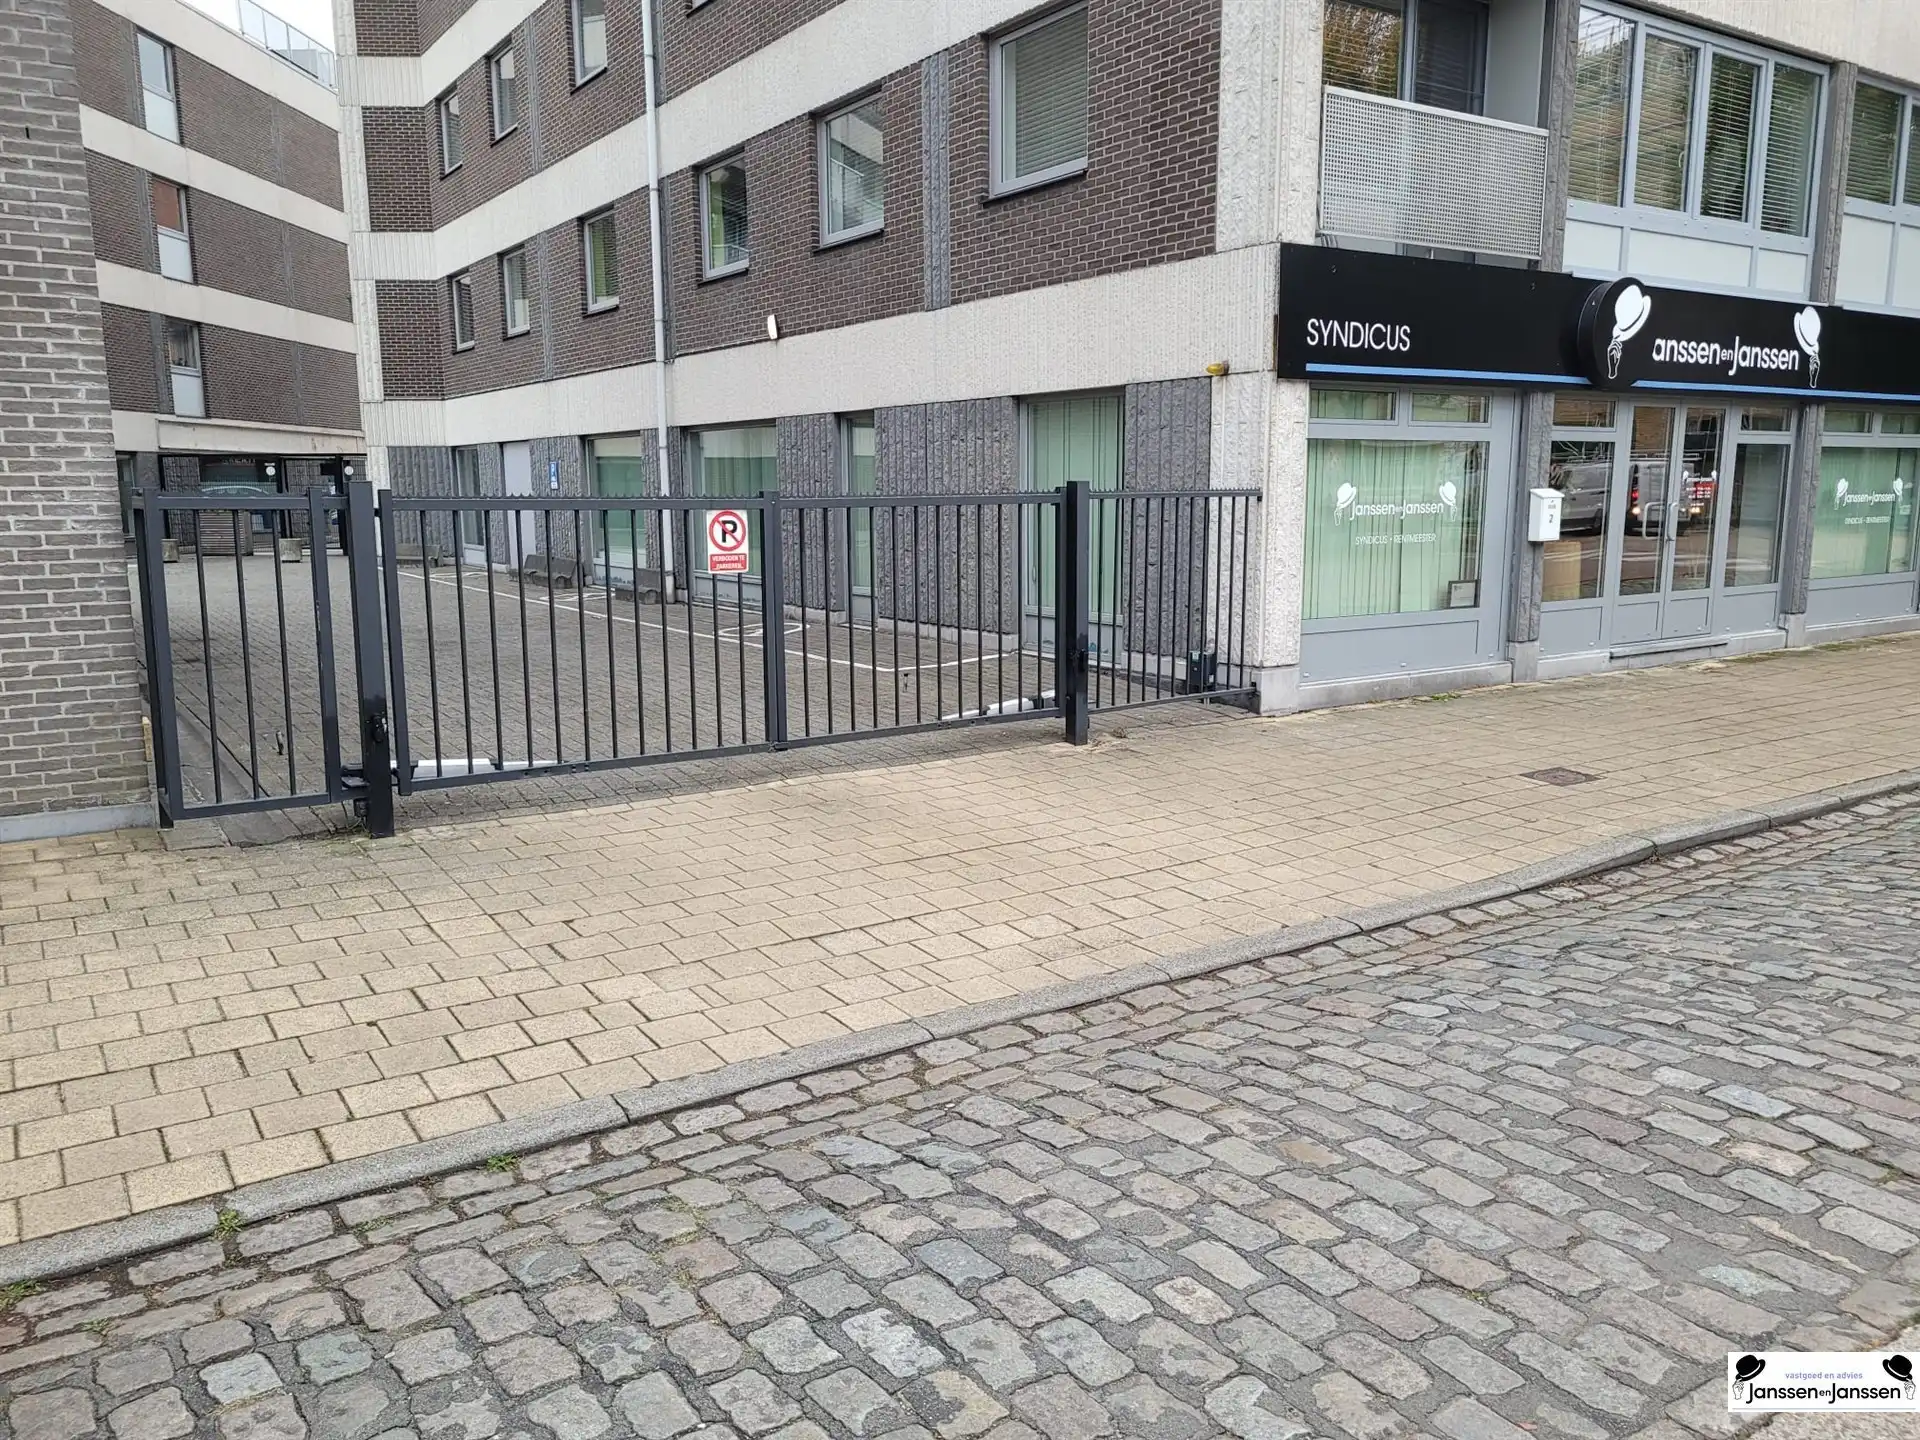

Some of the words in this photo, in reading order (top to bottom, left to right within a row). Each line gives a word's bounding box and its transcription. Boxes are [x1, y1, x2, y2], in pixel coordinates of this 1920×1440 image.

[1306, 318, 1411, 352] SYNDICUS
[1728, 335, 1800, 376] Janssen
[1349, 500, 1396, 521] Janssen
[1400, 499, 1444, 520] Janssen
[1355, 534, 1389, 546] SYNDICUS
